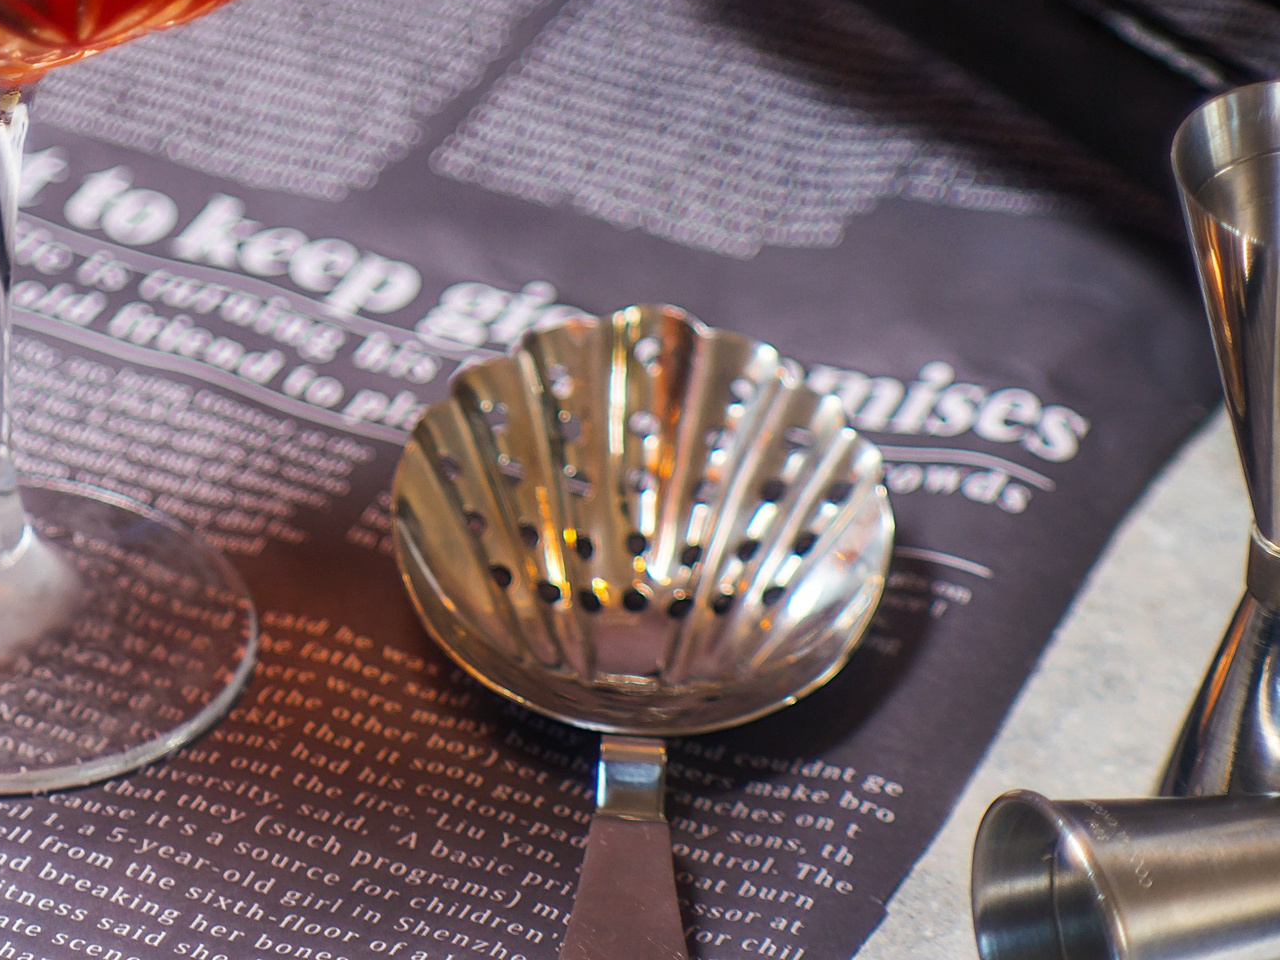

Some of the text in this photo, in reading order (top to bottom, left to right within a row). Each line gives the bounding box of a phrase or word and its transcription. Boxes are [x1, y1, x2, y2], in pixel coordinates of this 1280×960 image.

[63, 165, 178, 246] to
[175, 193, 422, 318] keep
[105, 826, 277, 896] 5-year-old
[279, 888, 345, 916] girl
[350, 903, 383, 925] in
[233, 840, 341, 888] source
[350, 877, 401, 902] for
[348, 848, 523, 910] programs)
[430, 838, 514, 877] basic
[795, 860, 854, 895] The
[38, 835, 114, 871] from
[125, 861, 176, 891] the
[184, 885, 360, 943] sixth-floor
[368, 939, 409, 957] of
[38, 861, 183, 927] breaking
[188, 913, 246, 942] her
[737, 879, 815, 911] burn
[769, 915, 806, 937] at
[96, 915, 167, 949] said
